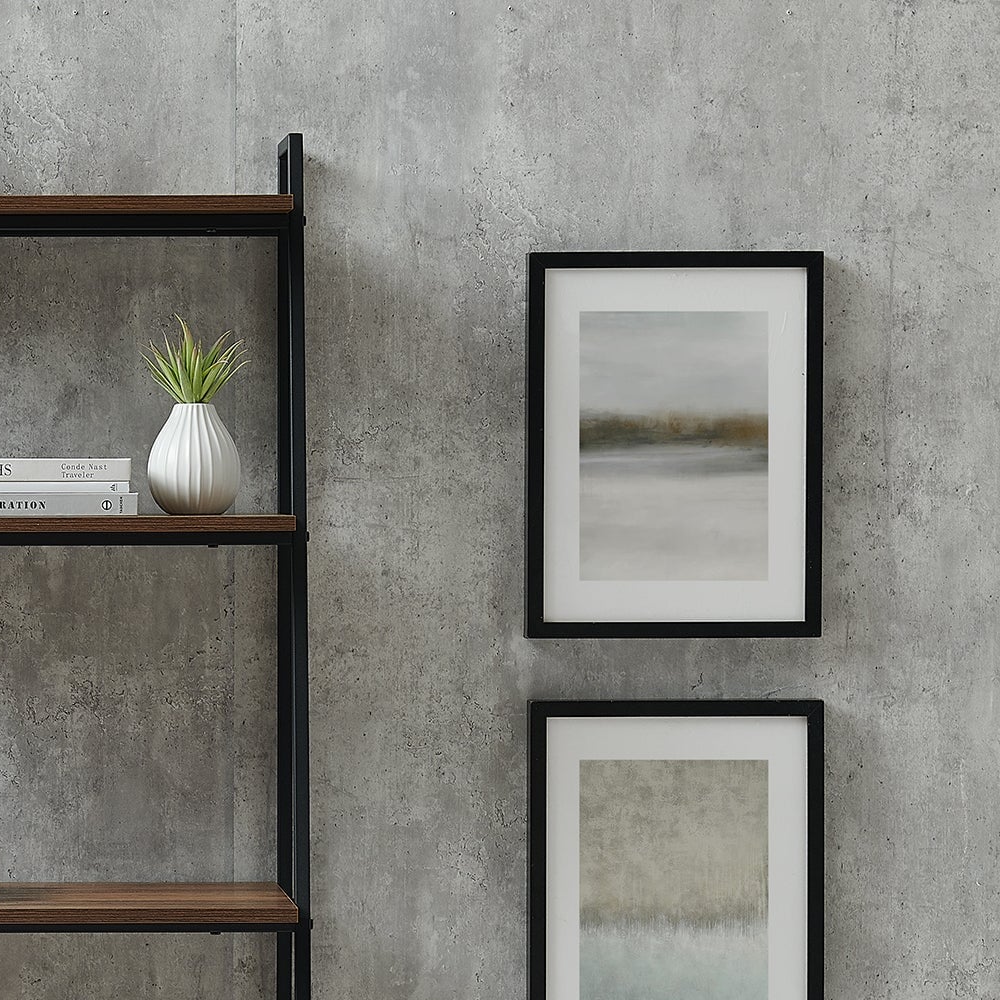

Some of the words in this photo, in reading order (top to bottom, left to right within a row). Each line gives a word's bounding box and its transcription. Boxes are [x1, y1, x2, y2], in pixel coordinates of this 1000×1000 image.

[61, 463, 86, 471] Conde
[88, 463, 108, 471] Nast
[61, 471, 95, 479] Traveler
